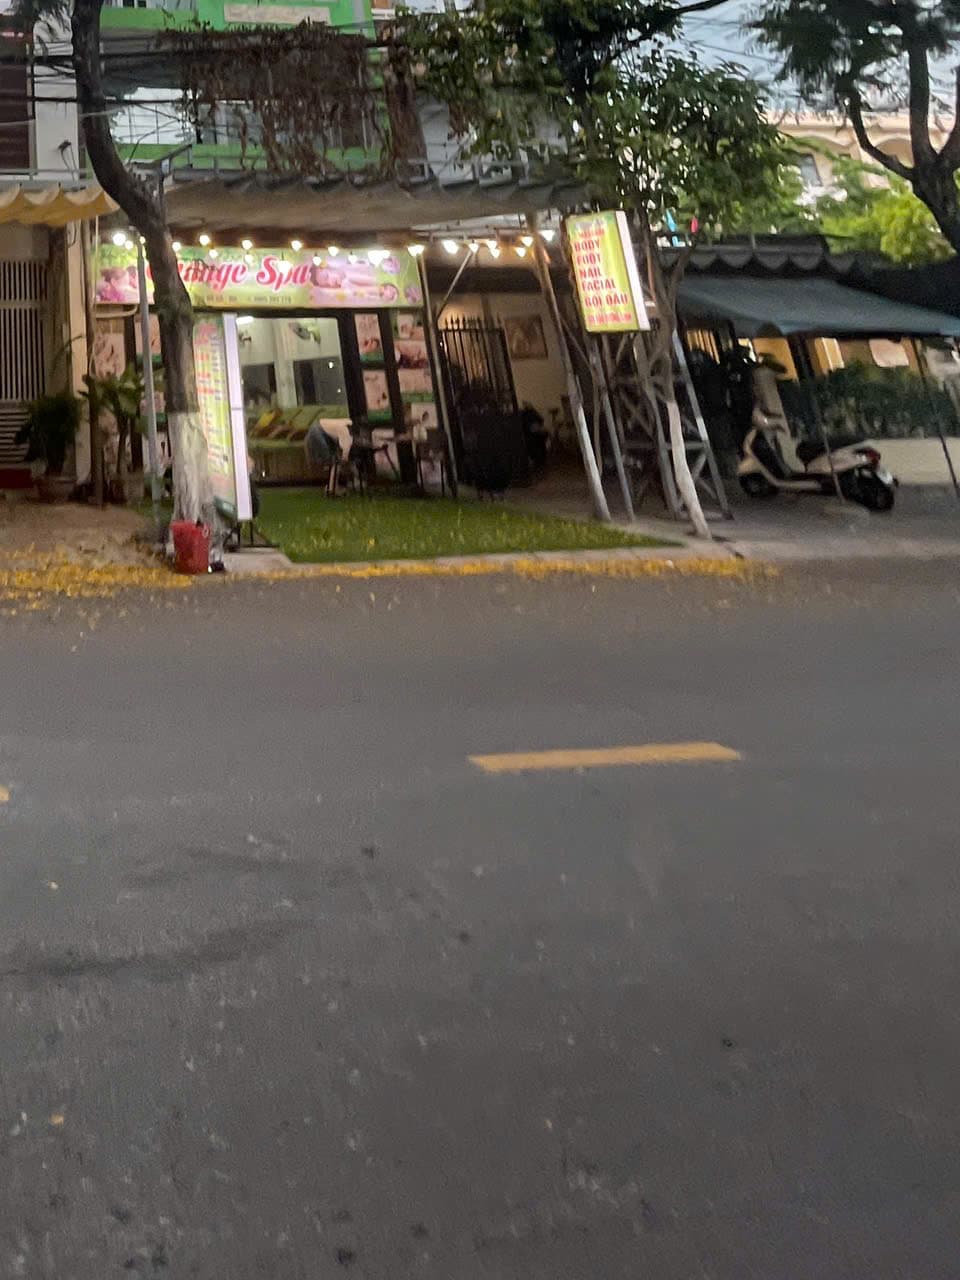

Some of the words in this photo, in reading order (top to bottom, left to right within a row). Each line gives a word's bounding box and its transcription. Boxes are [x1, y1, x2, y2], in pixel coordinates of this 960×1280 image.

[574, 239, 601, 252] BODY
[256, 255, 311, 291] Spa
[579, 267, 602, 279] NAIL
[581, 279, 617, 291] FACIAL
